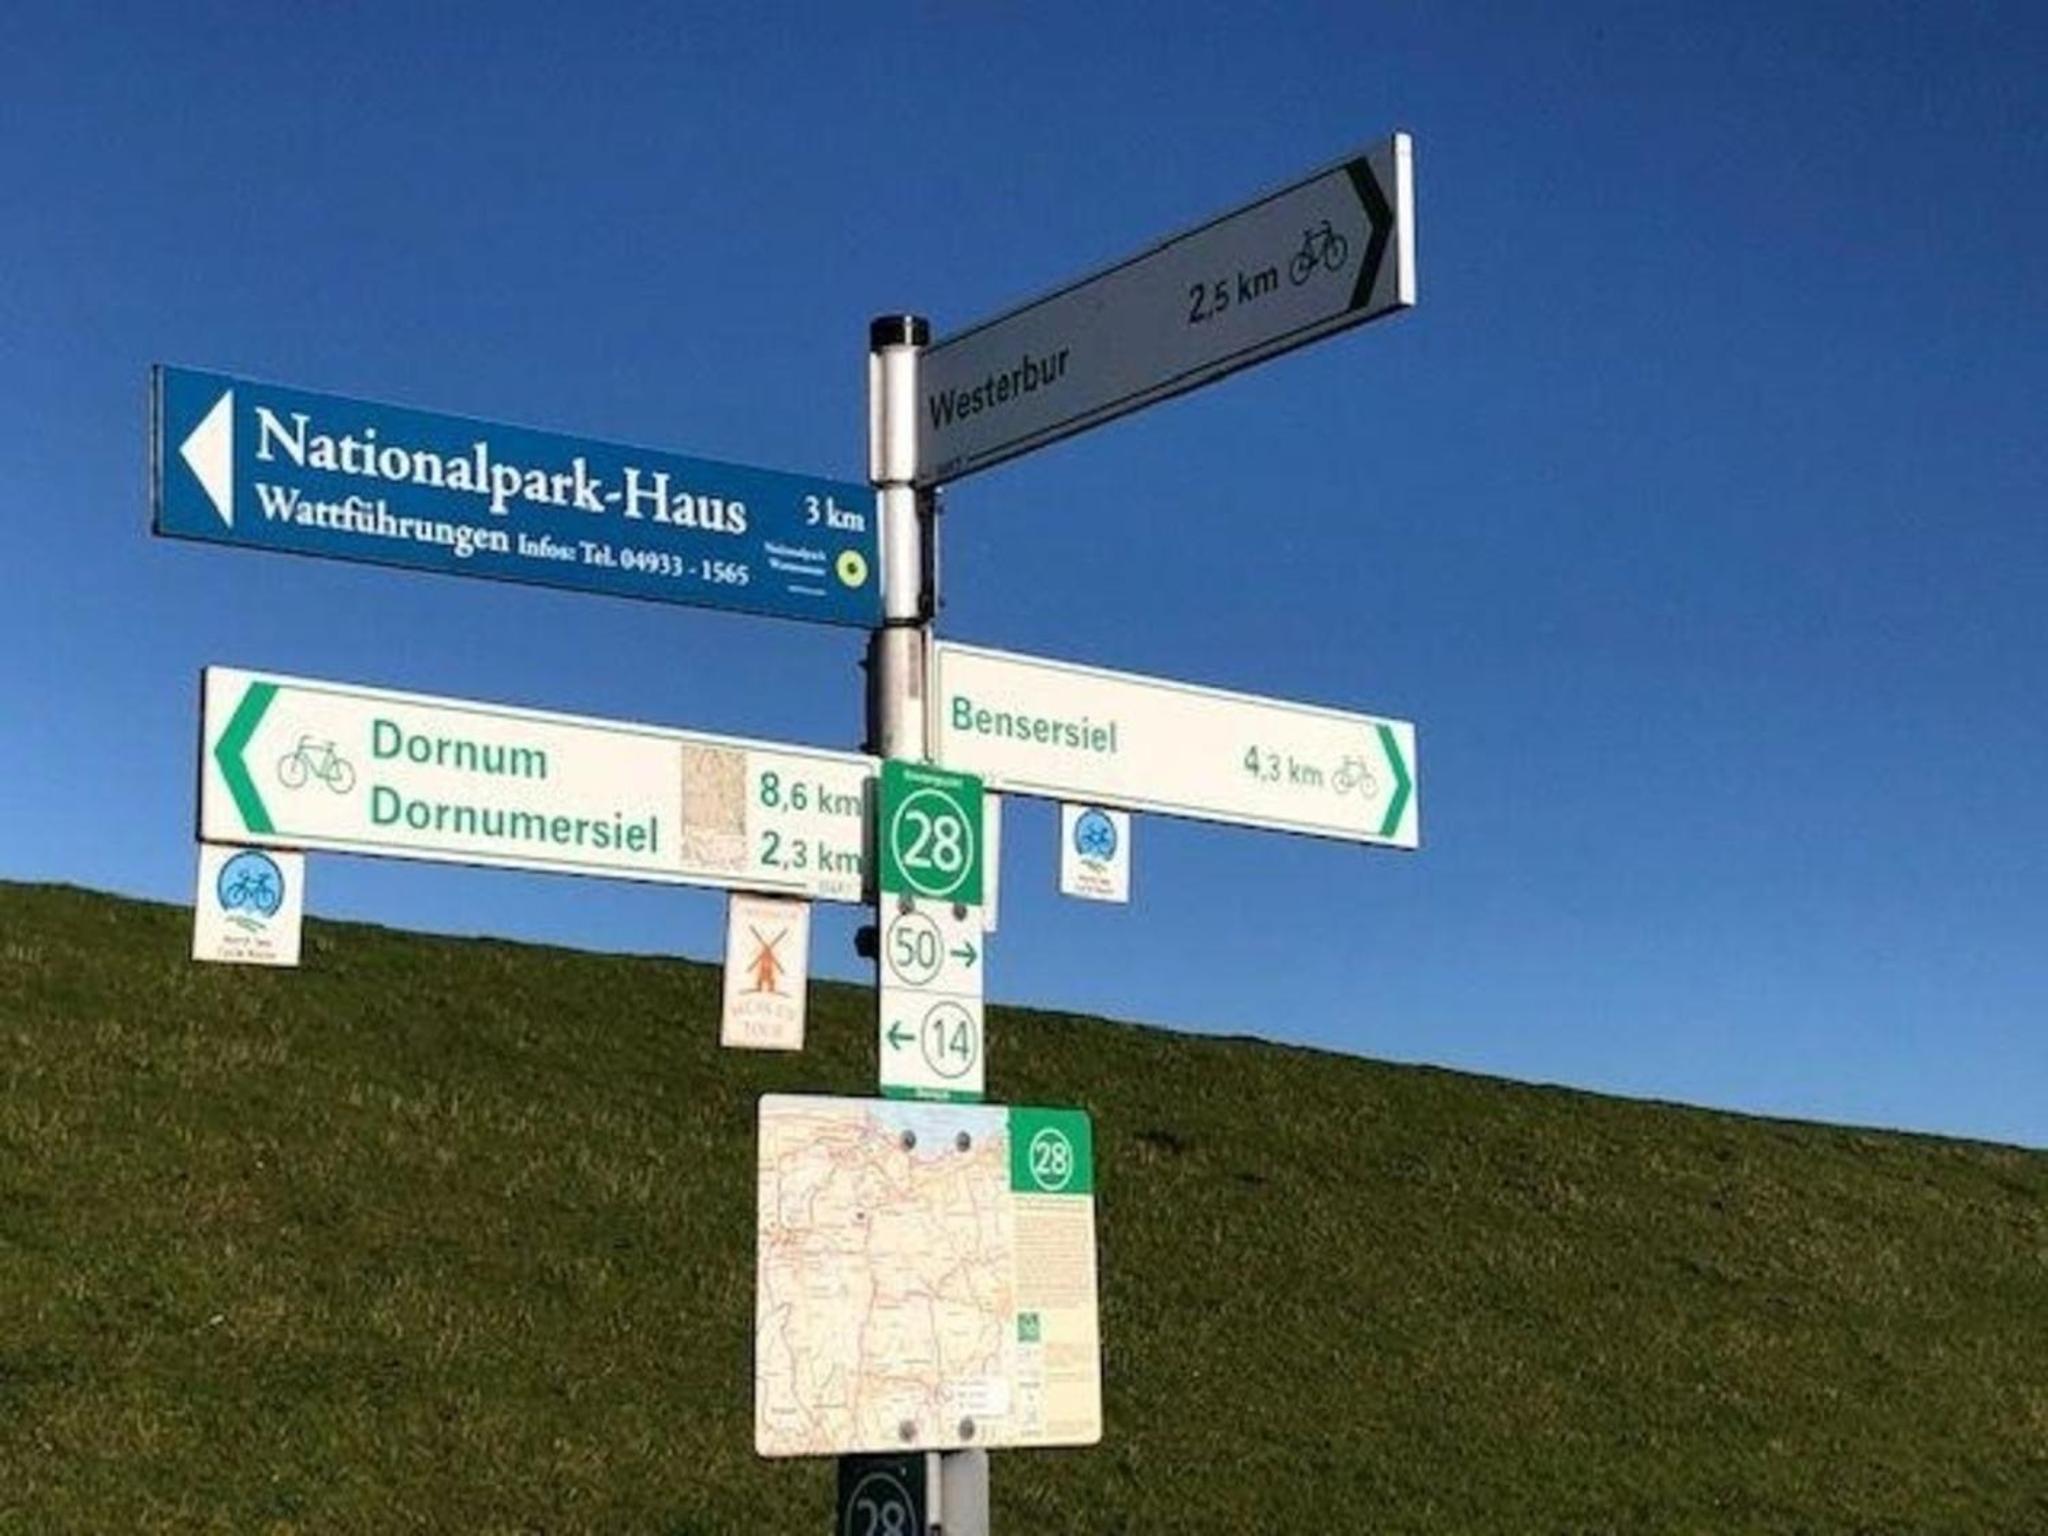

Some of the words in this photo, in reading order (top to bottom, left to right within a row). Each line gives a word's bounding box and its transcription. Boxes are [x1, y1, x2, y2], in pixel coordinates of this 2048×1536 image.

[1188, 283, 1231, 324] 2,5
[1237, 265, 1278, 305] km
[928, 346, 1071, 430] Westerbur
[255, 406, 748, 535] Nationalpark-Haus
[254, 482, 509, 558] Wattführungen
[620, 547, 683, 577] 04933
[702, 559, 750, 586] 1565
[804, 494, 821, 526] 3
[826, 496, 866, 532] km
[372, 719, 548, 780] Dornum
[951, 696, 1118, 753] Bensersiel
[1244, 745, 1281, 782] 4,3
[1288, 756, 1324, 788] km
[371, 785, 658, 853] Dornumersiel
[760, 771, 808, 812] 8,6
[818, 783, 862, 816] km
[760, 830, 808, 871] 2,3
[818, 841, 863, 875] km
[903, 809, 963, 872] 28
[895, 927, 936, 969] 50
[933, 1018, 969, 1062] 14
[1036, 1141, 1067, 1174] 28
[857, 1500, 905, 1536] 28
